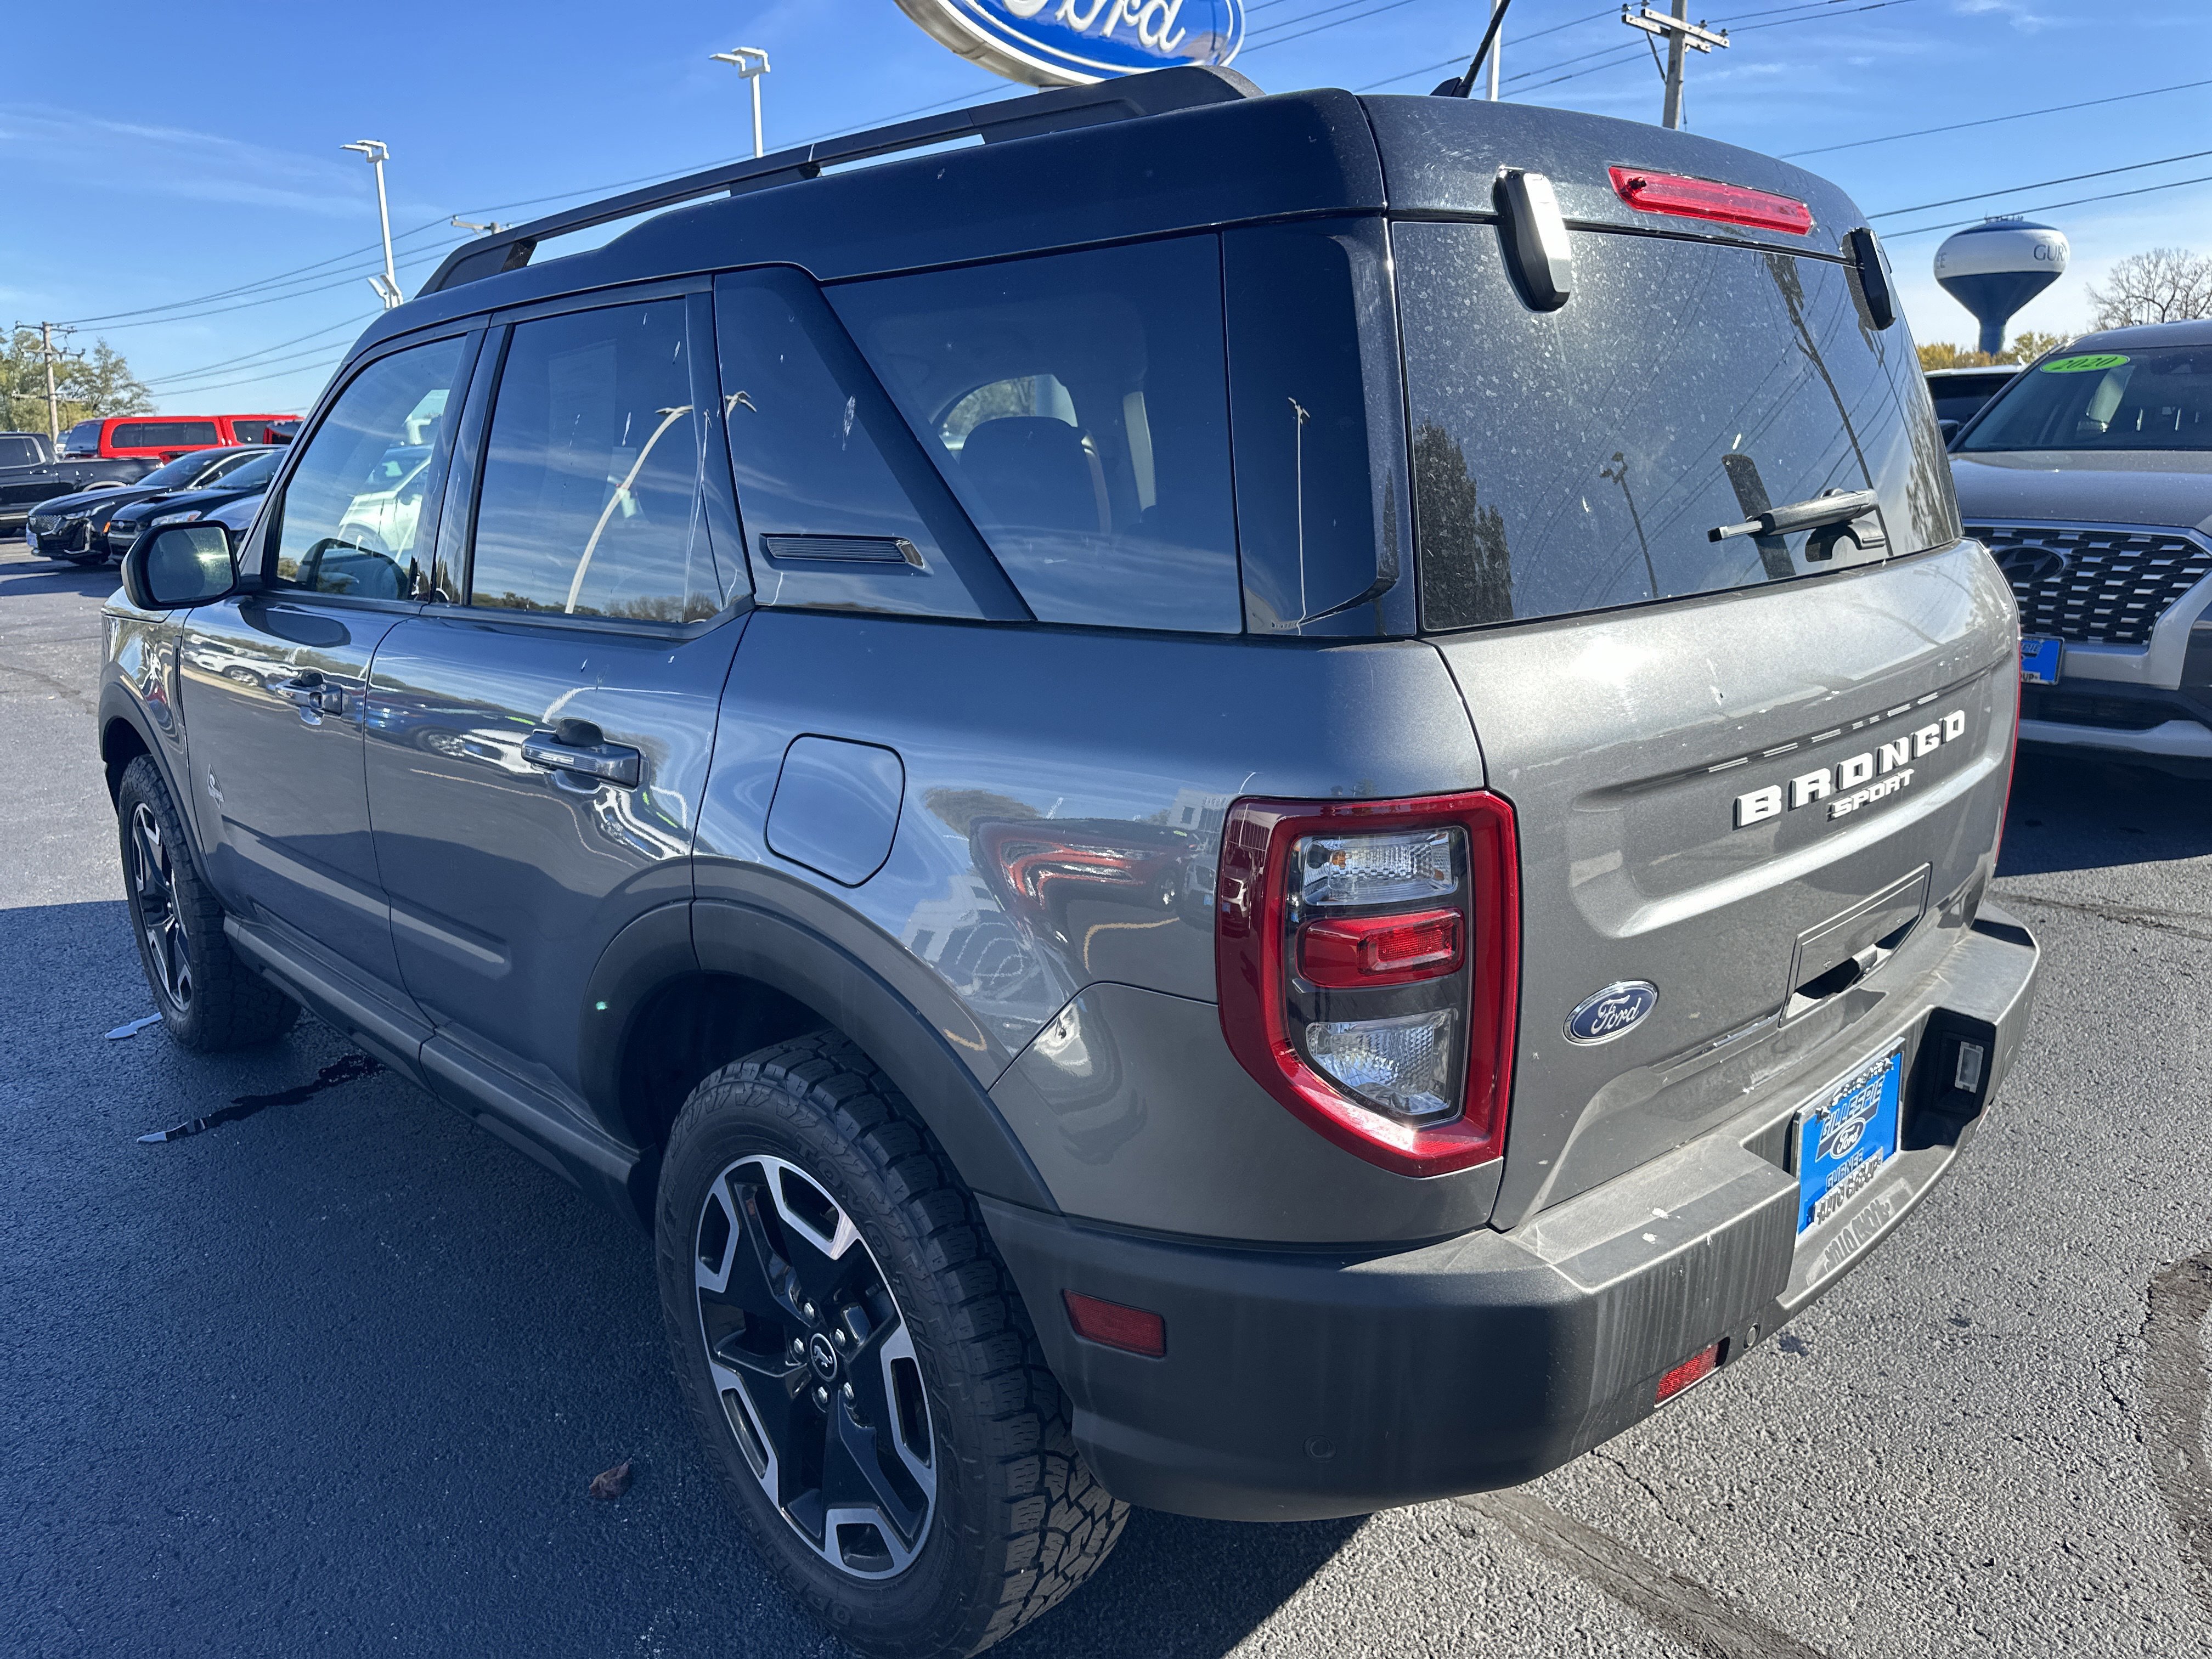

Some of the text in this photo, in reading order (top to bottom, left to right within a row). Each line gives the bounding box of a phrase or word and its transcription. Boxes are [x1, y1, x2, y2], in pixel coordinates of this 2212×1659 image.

[2051, 357, 2118, 370] 2020
[1737, 710, 1965, 827] BRONCO
[1830, 769, 1914, 818] SPORT
[1592, 995, 1641, 1035] Ford
[1820, 1075, 1886, 1142] GILLESPIE
[1837, 1124, 1859, 1154] Ford
[1825, 1147, 1864, 1192] GURNEE
[794, 1134, 893, 1261] TOYO
